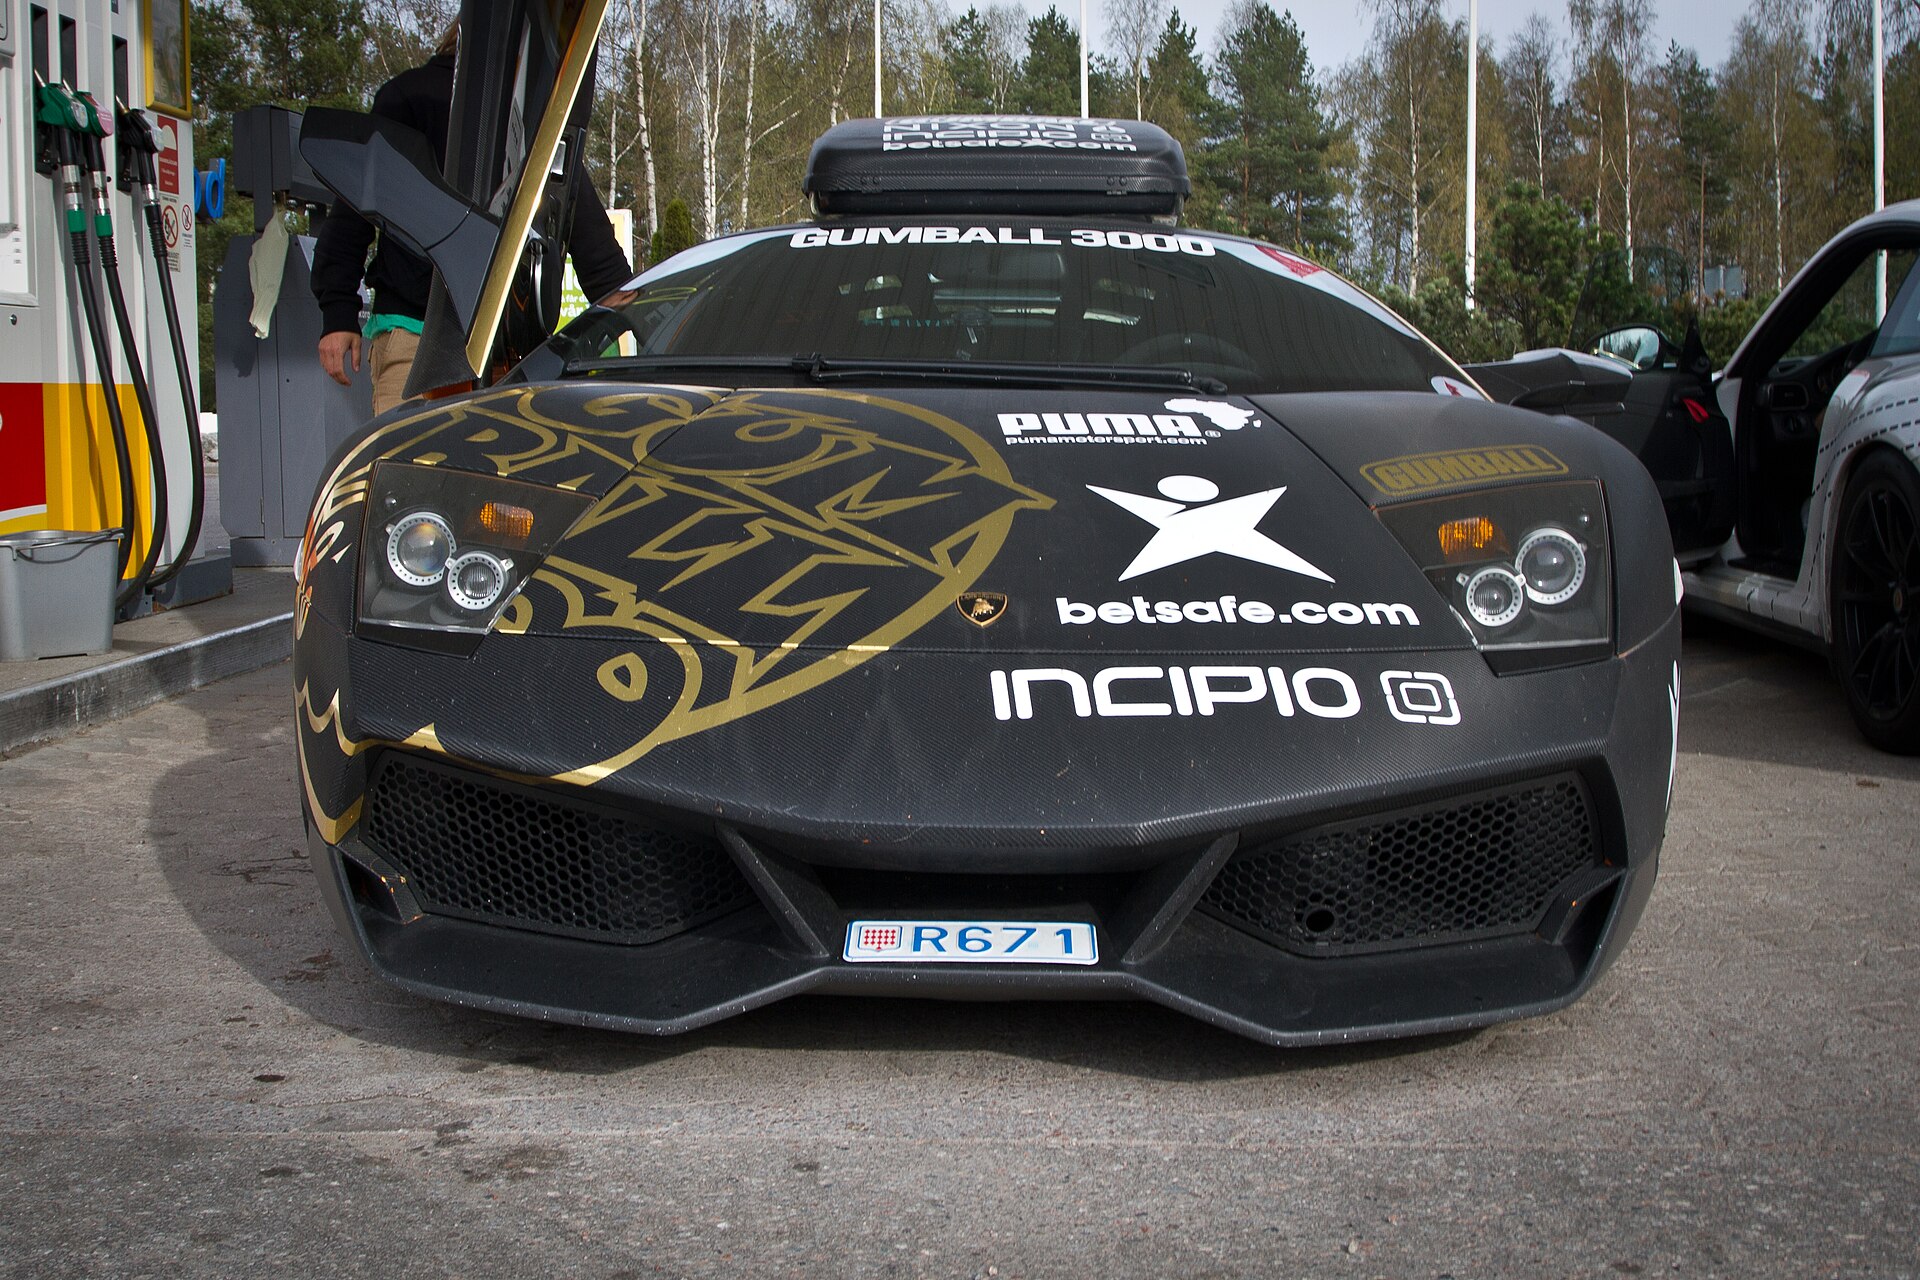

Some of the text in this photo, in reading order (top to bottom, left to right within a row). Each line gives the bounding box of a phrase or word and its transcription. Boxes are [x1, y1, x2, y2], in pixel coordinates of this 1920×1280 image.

[789, 226, 1217, 257] GUMBALL 3000
[996, 413, 1202, 437] PUMA
[1006, 434, 1208, 446] pumamotorsport.com
[1373, 449, 1557, 490] GUMBALL
[1056, 594, 1420, 628] betsafe.com
[989, 666, 1362, 721] INCIPIO
